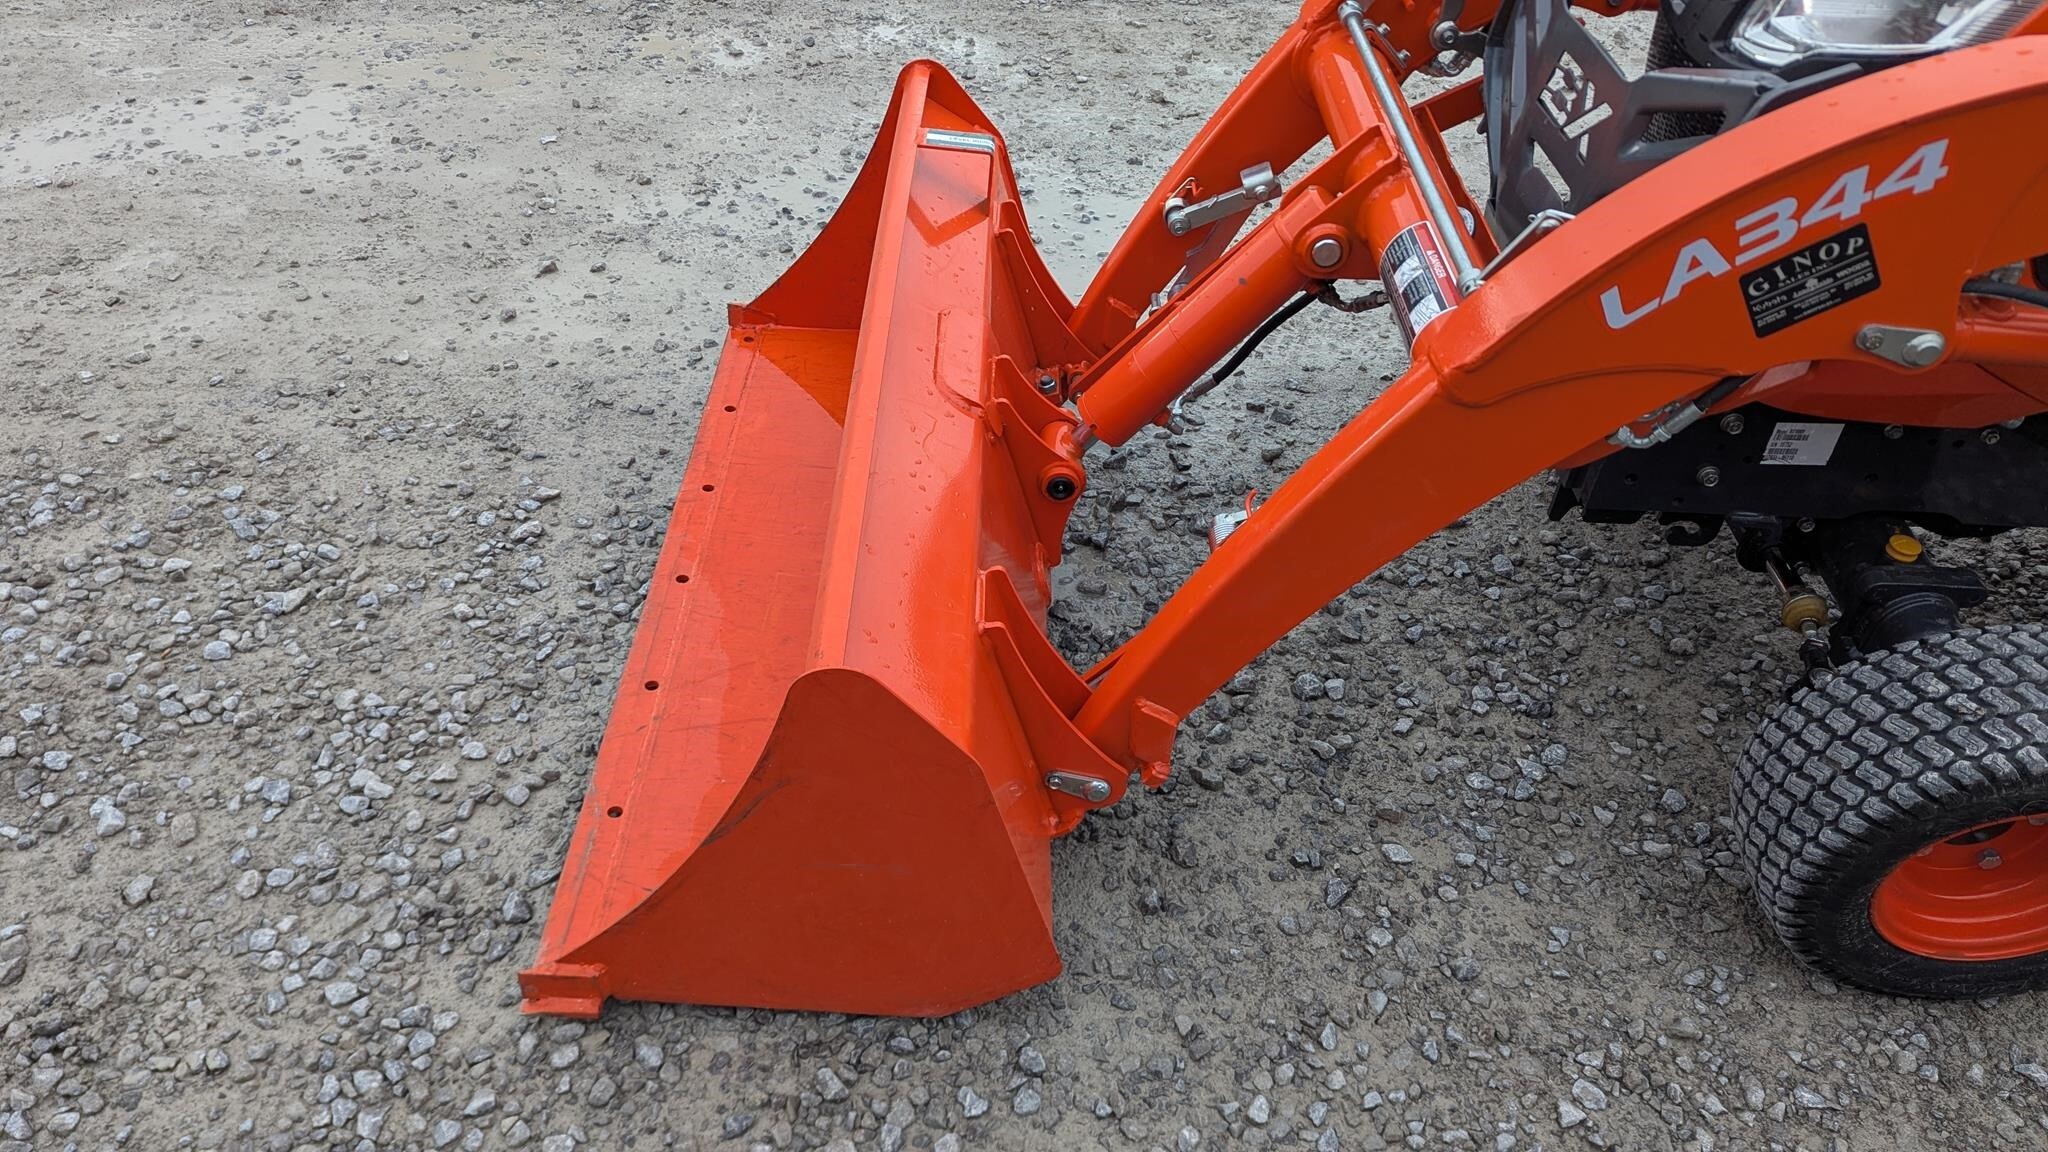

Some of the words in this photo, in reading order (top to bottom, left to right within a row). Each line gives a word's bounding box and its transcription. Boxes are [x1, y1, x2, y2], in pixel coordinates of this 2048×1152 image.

[1600, 138, 1949, 329] LA344
[1428, 253, 1447, 279] DANGER
[1748, 237, 1864, 297] GINOP
[1752, 294, 1788, 312] Kubota
